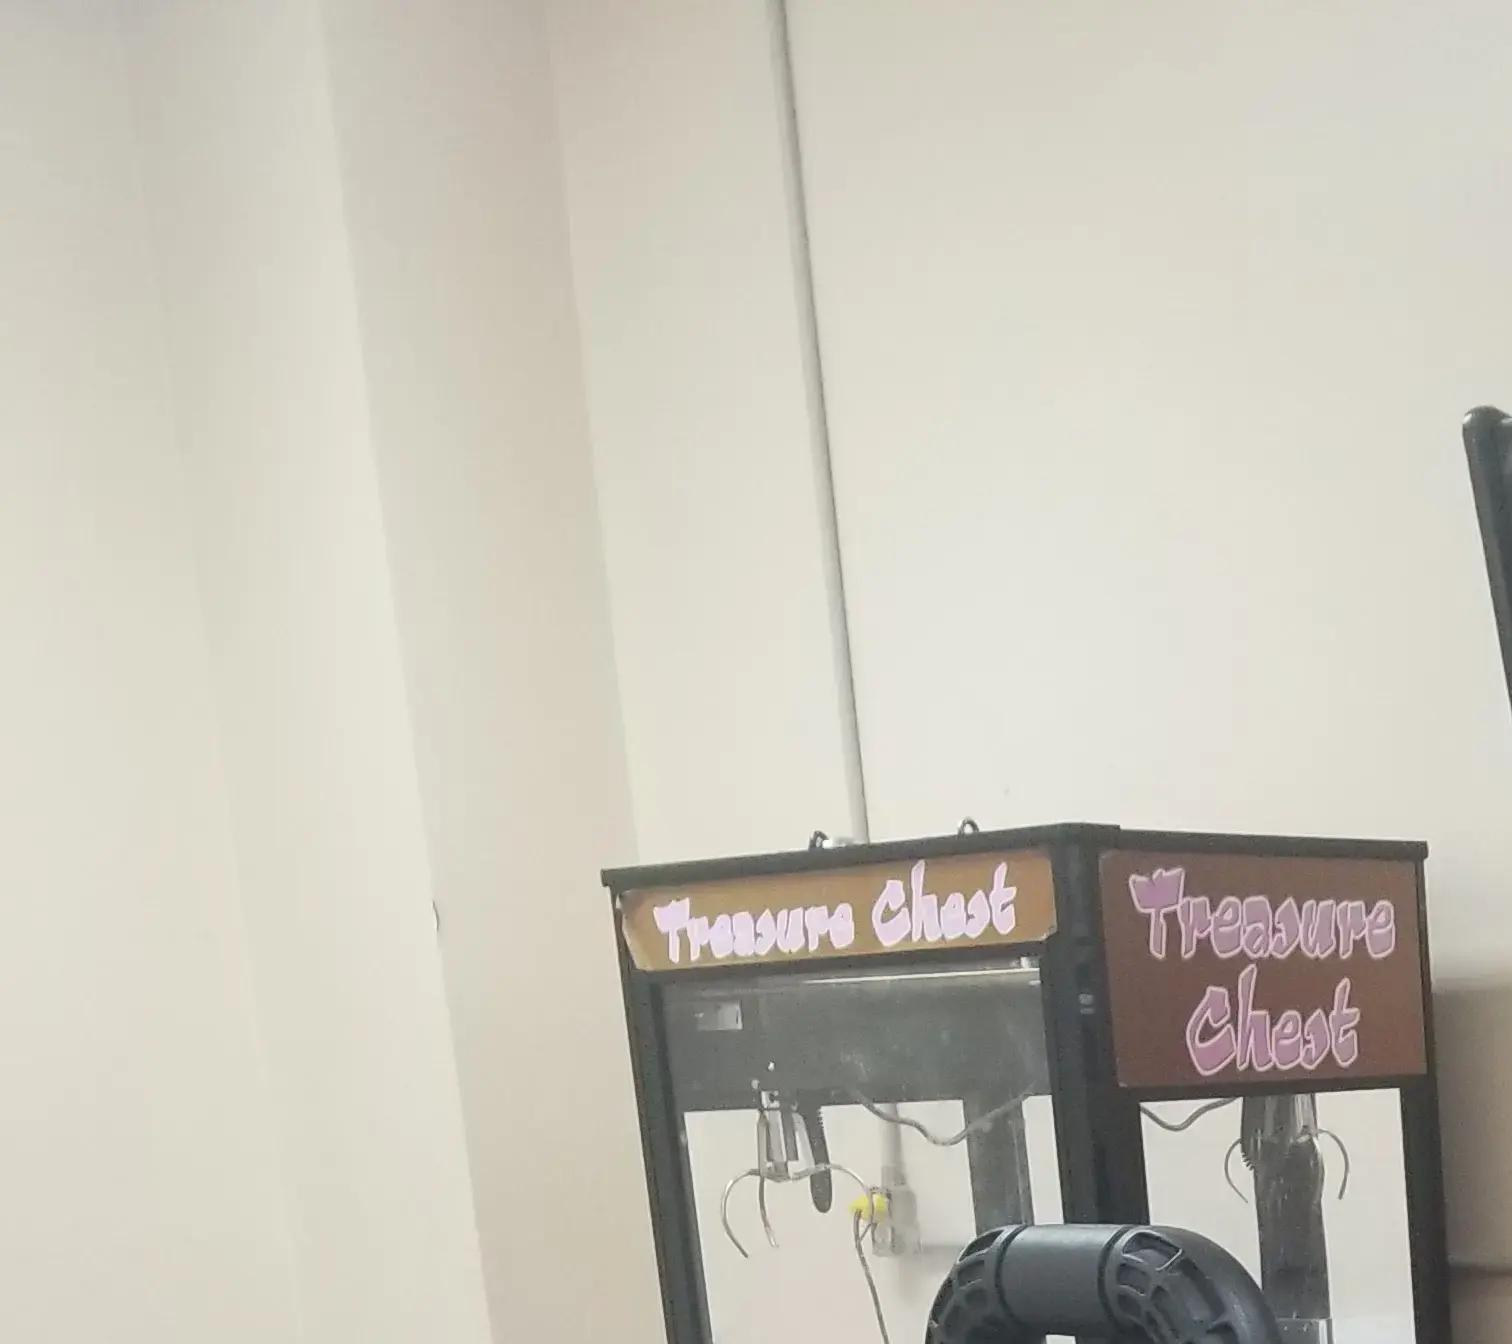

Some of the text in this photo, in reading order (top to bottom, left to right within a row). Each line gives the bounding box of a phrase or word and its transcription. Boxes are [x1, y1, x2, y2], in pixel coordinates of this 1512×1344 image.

[653, 859, 1017, 964] Treasure Chest
[1129, 867, 1395, 960] Treasure
[1186, 964, 1361, 1076] Chest
